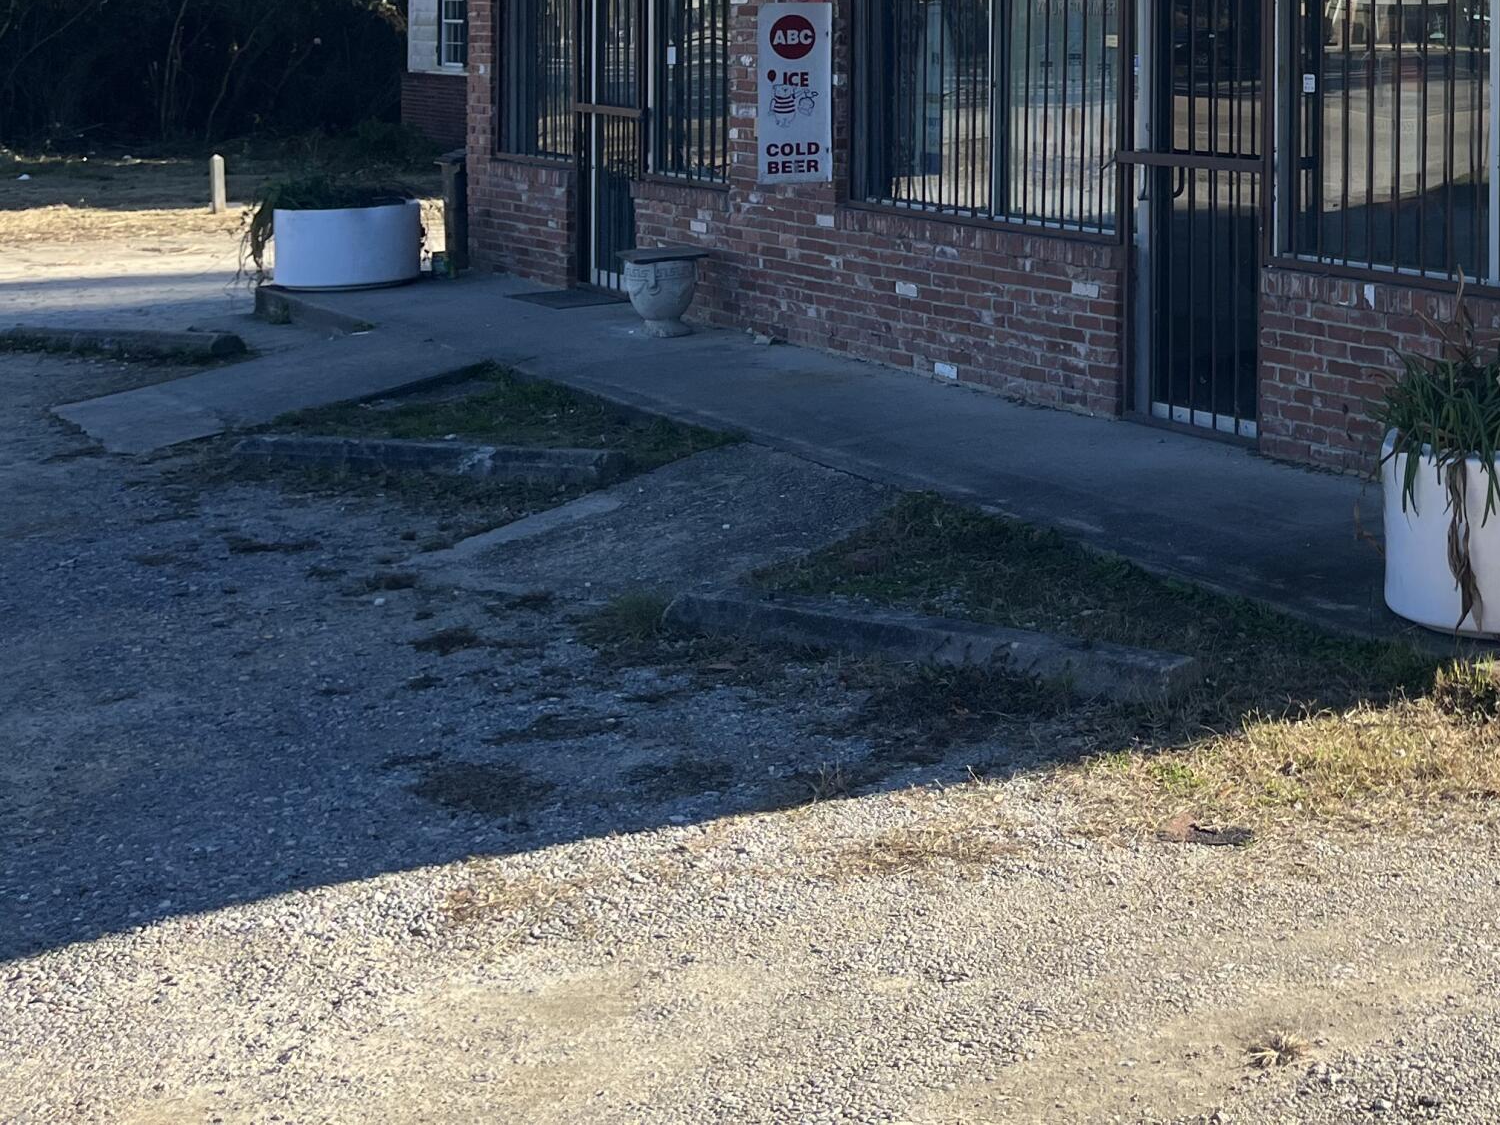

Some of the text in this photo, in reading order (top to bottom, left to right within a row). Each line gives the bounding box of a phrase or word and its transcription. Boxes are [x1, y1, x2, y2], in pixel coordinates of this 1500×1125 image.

[772, 29, 815, 46] ABC
[783, 71, 809, 87] ICE
[766, 142, 820, 157] COLD
[768, 159, 819, 175] BEER
